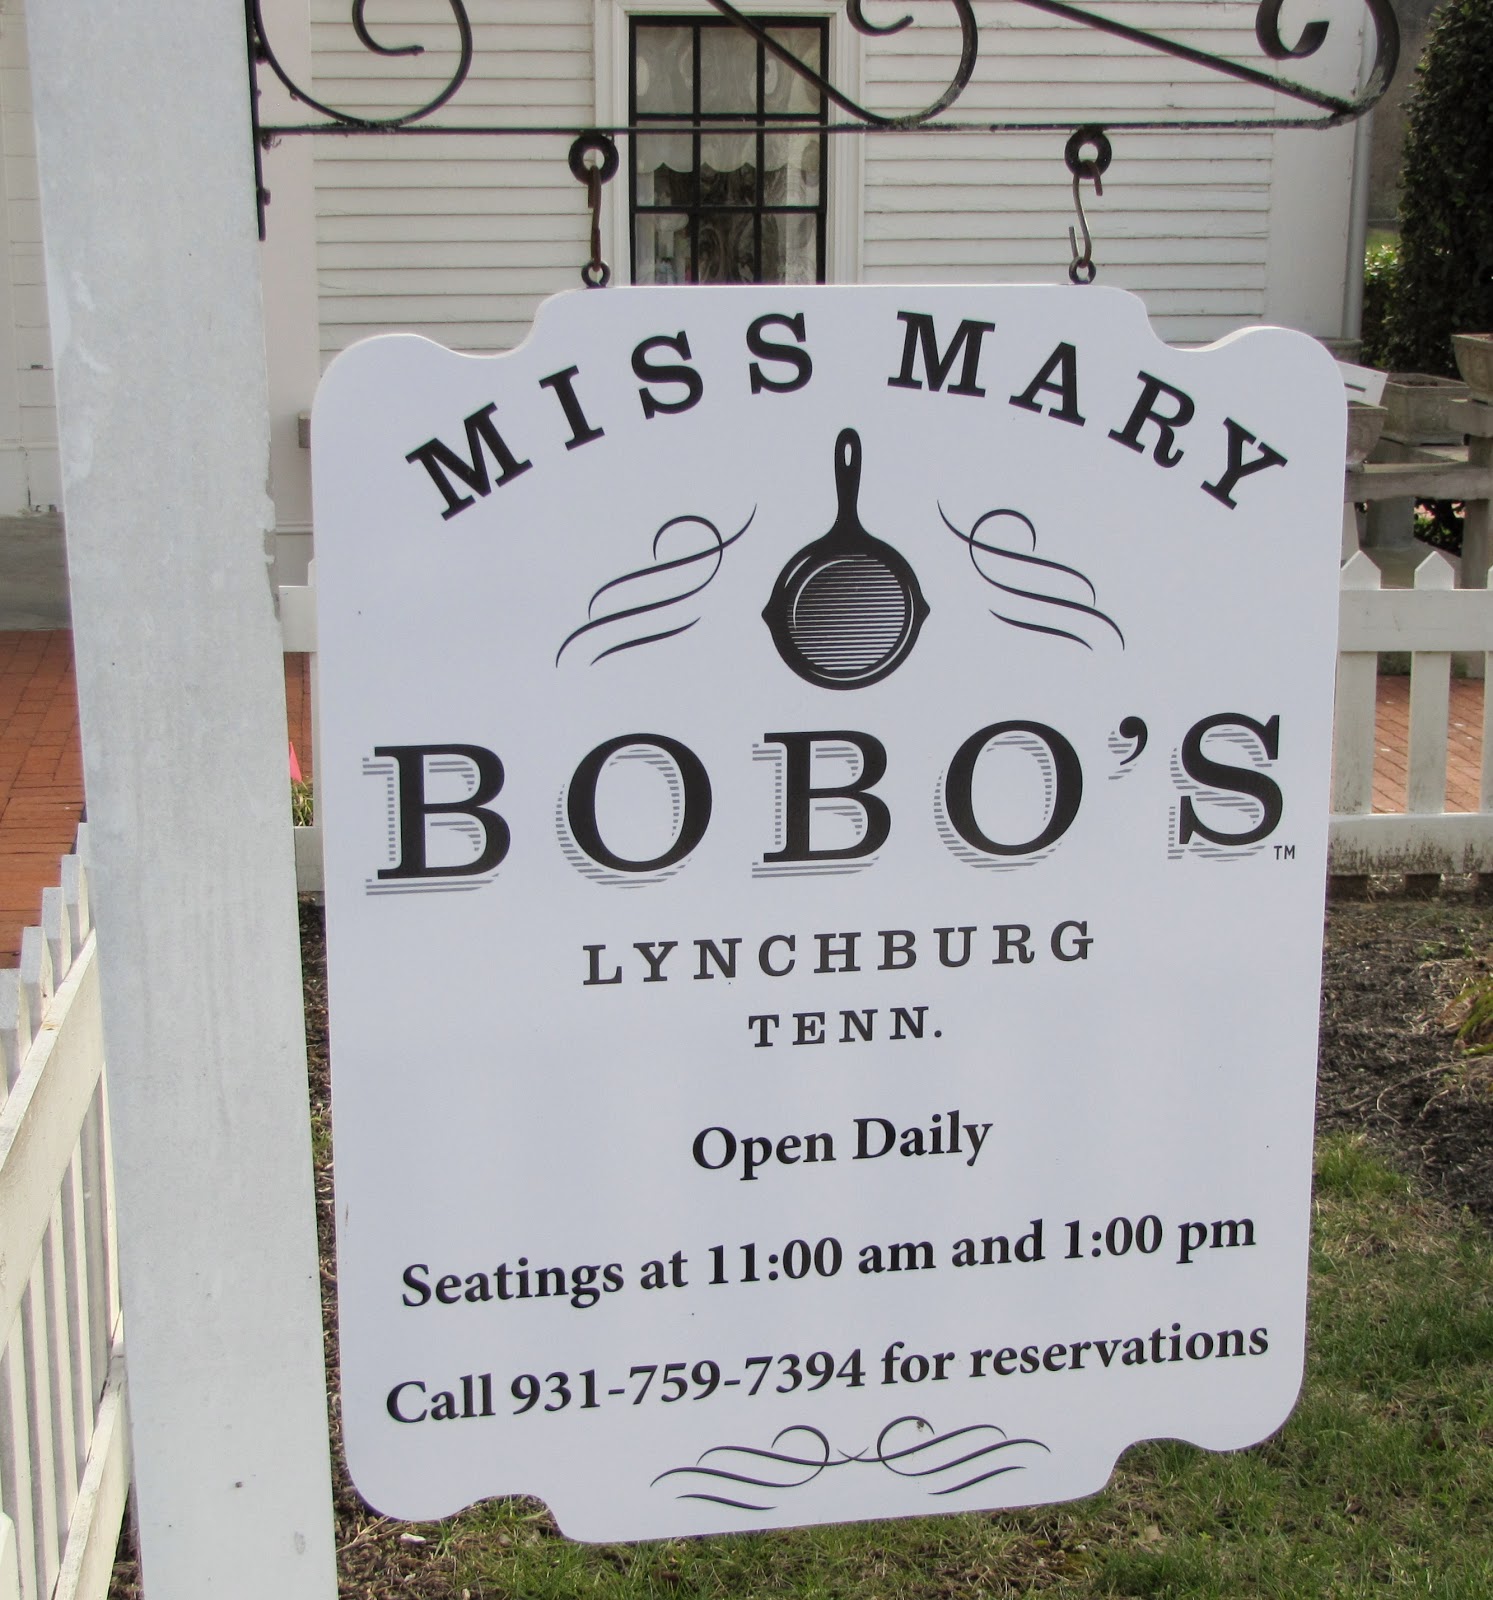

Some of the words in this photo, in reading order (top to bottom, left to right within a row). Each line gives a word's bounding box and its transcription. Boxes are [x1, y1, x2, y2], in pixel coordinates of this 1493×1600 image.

[404, 312, 813, 522] MISS
[887, 310, 1289, 511] MARY
[362, 712, 1284, 896] BOBO'S
[582, 920, 1094, 986] LYNCHBURG
[748, 1005, 943, 1048] TENN.
[692, 1126, 837, 1182] Open
[852, 1109, 994, 1167] Daily
[401, 1256, 625, 1309] Seatings
[640, 1250, 689, 1291] at
[708, 1236, 843, 1285] 11:00
[858, 1241, 937, 1275] am
[951, 1218, 1046, 1268] and
[1064, 1214, 1163, 1260] 1:00
[1175, 1218, 1257, 1265] pm
[386, 1372, 497, 1424] Call
[510, 1348, 866, 1416] 931-759-7394
[880, 1341, 956, 1385] for
[968, 1322, 1269, 1378] reservations
